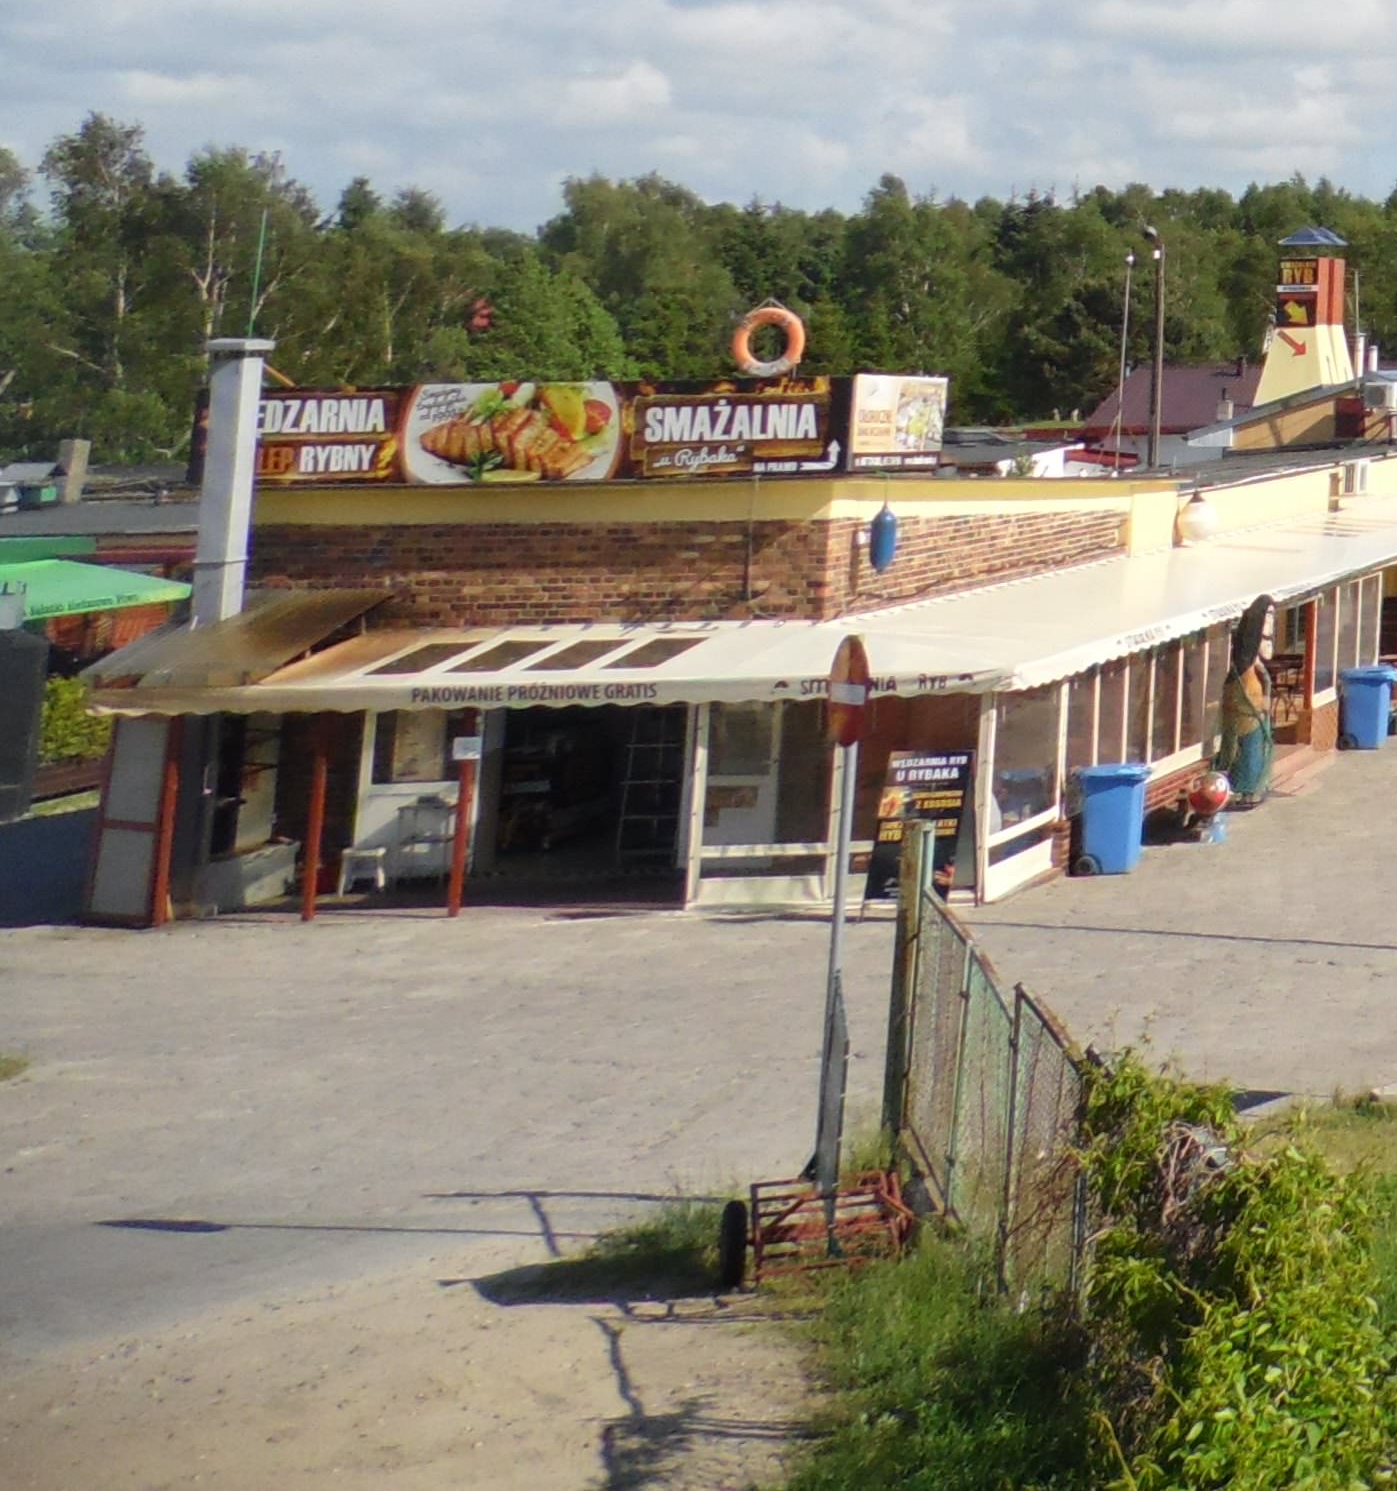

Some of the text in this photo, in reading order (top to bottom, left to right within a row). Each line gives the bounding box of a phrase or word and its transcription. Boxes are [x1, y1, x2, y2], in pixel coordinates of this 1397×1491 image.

[644, 399, 818, 442] SMAŻALNIA
[300, 444, 376, 473] RYBNY
[411, 682, 658, 703] PAKOWANIE PRÓŻNIOWE GRATIS
[896, 768, 959, 782] U RYBAKA
